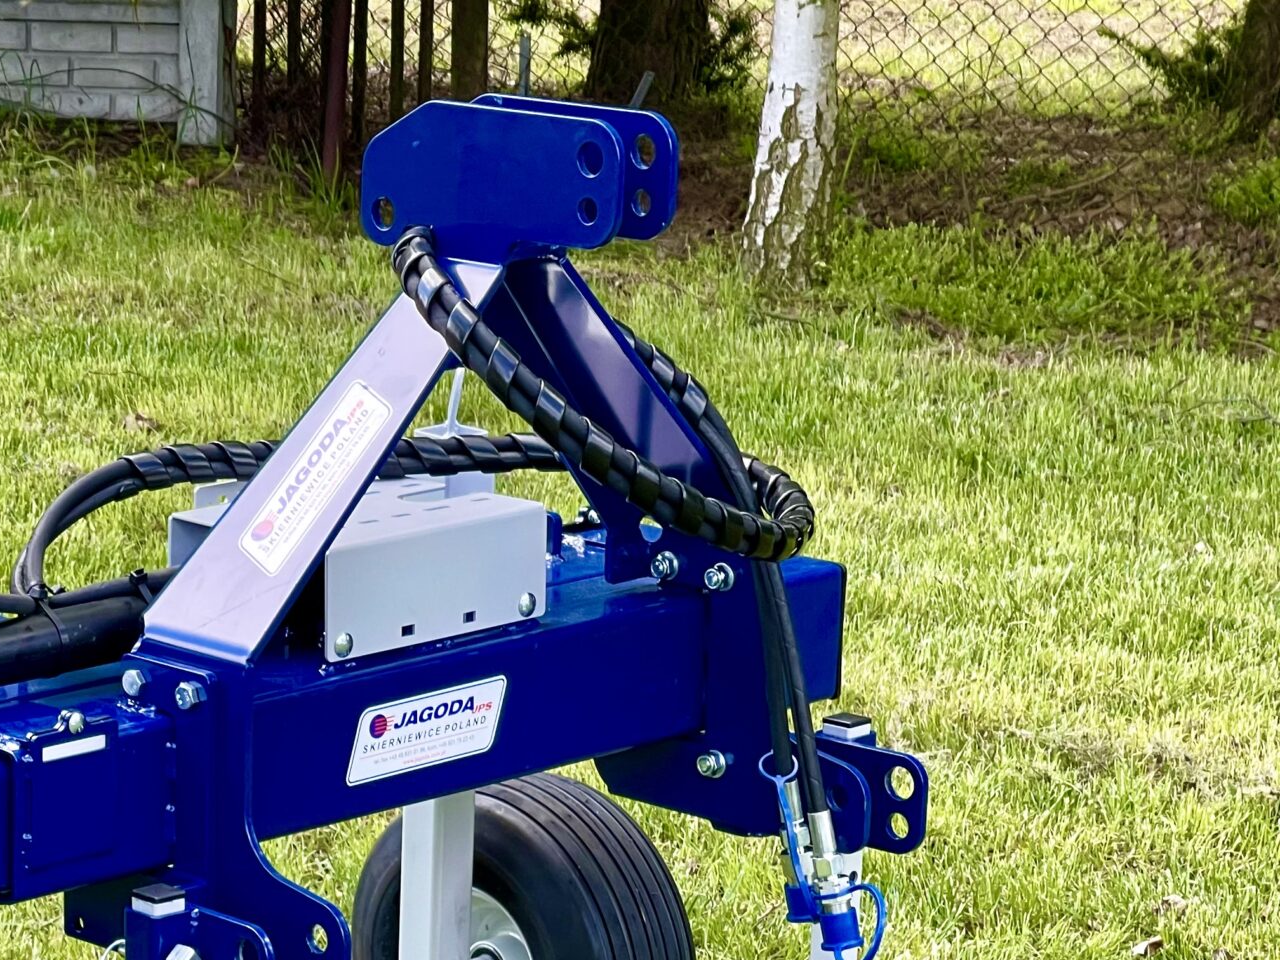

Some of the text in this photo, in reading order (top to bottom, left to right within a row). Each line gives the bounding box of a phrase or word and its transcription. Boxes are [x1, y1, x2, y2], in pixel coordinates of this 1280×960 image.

[332, 409, 369, 461] POLAND
[277, 418, 348, 515] JAGODA
[362, 726, 442, 754] SKIERNIEWICE
[444, 715, 487, 735] POLAND
[393, 696, 475, 730] JAGODA
